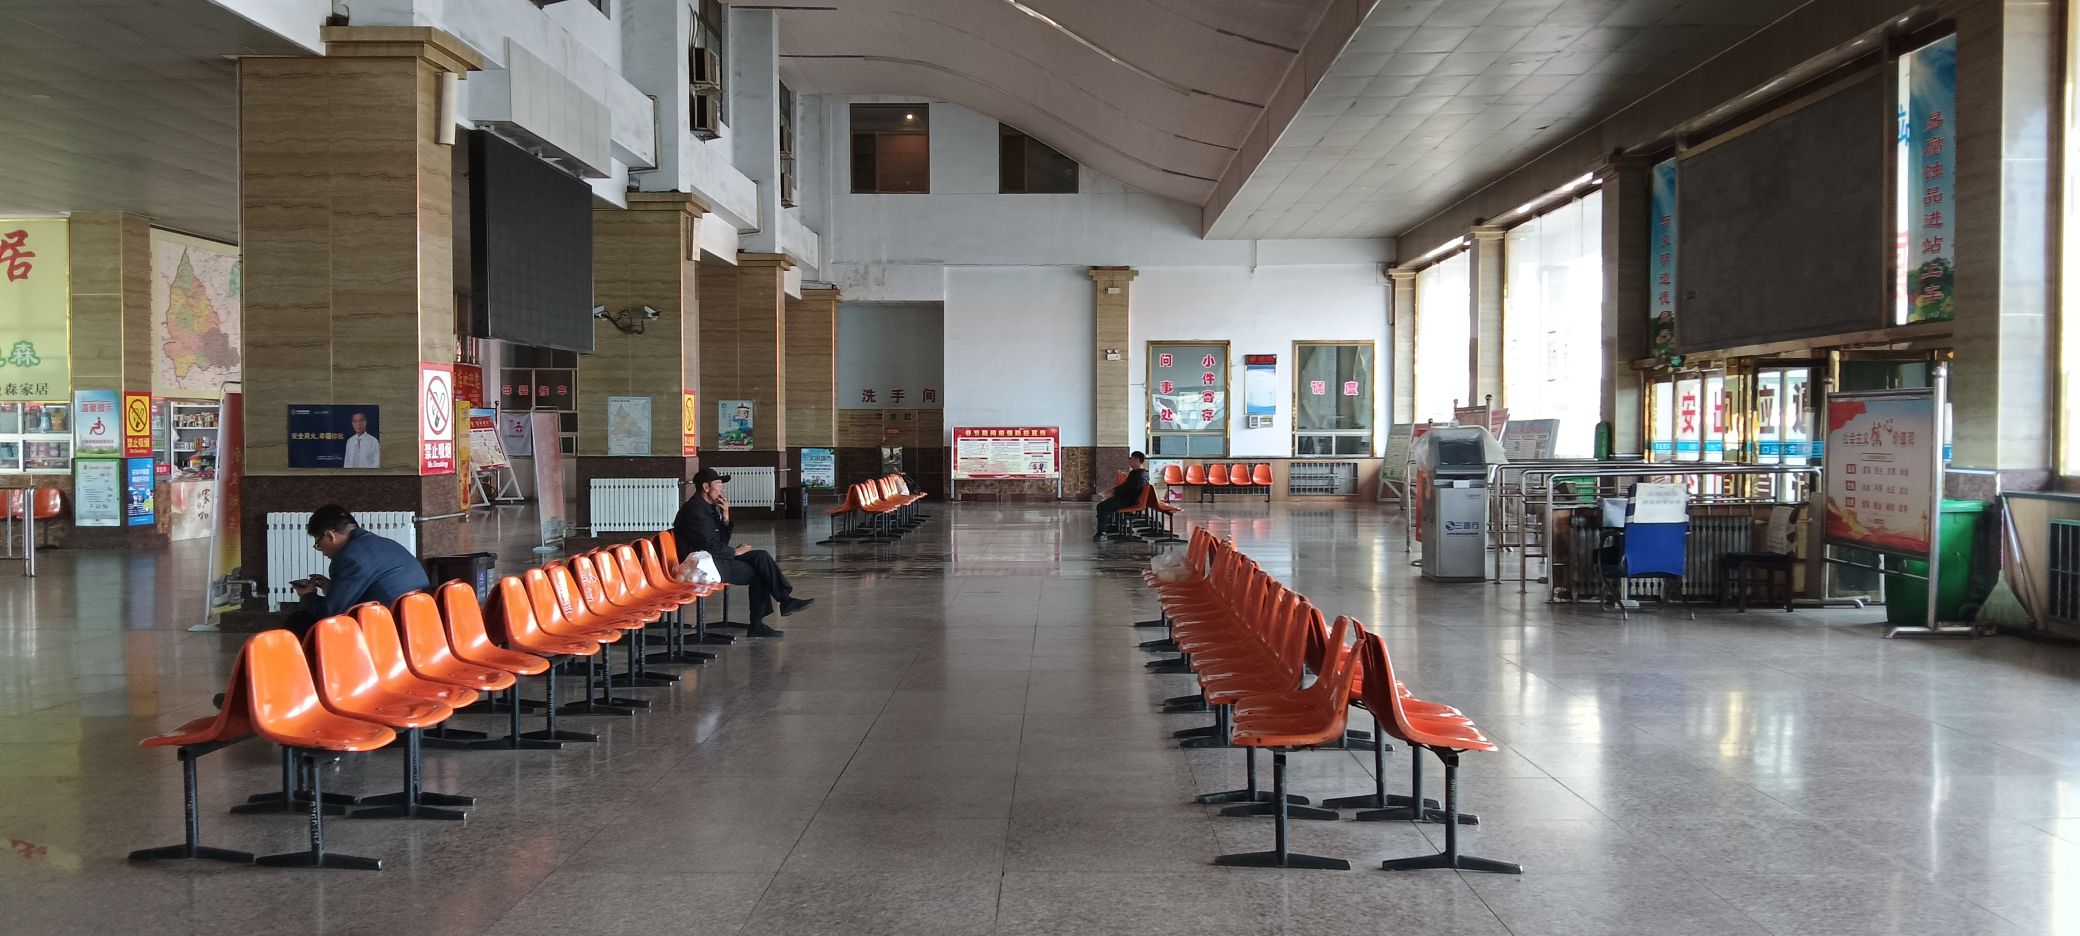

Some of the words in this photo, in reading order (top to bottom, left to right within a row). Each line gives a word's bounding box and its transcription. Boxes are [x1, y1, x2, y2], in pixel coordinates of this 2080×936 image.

[862, 388, 936, 403] 洗手间
[1160, 353, 1173, 422] 问事处
[1201, 353, 1216, 422] 小件寄存
[424, 443, 452, 459] 禁止吸烟
